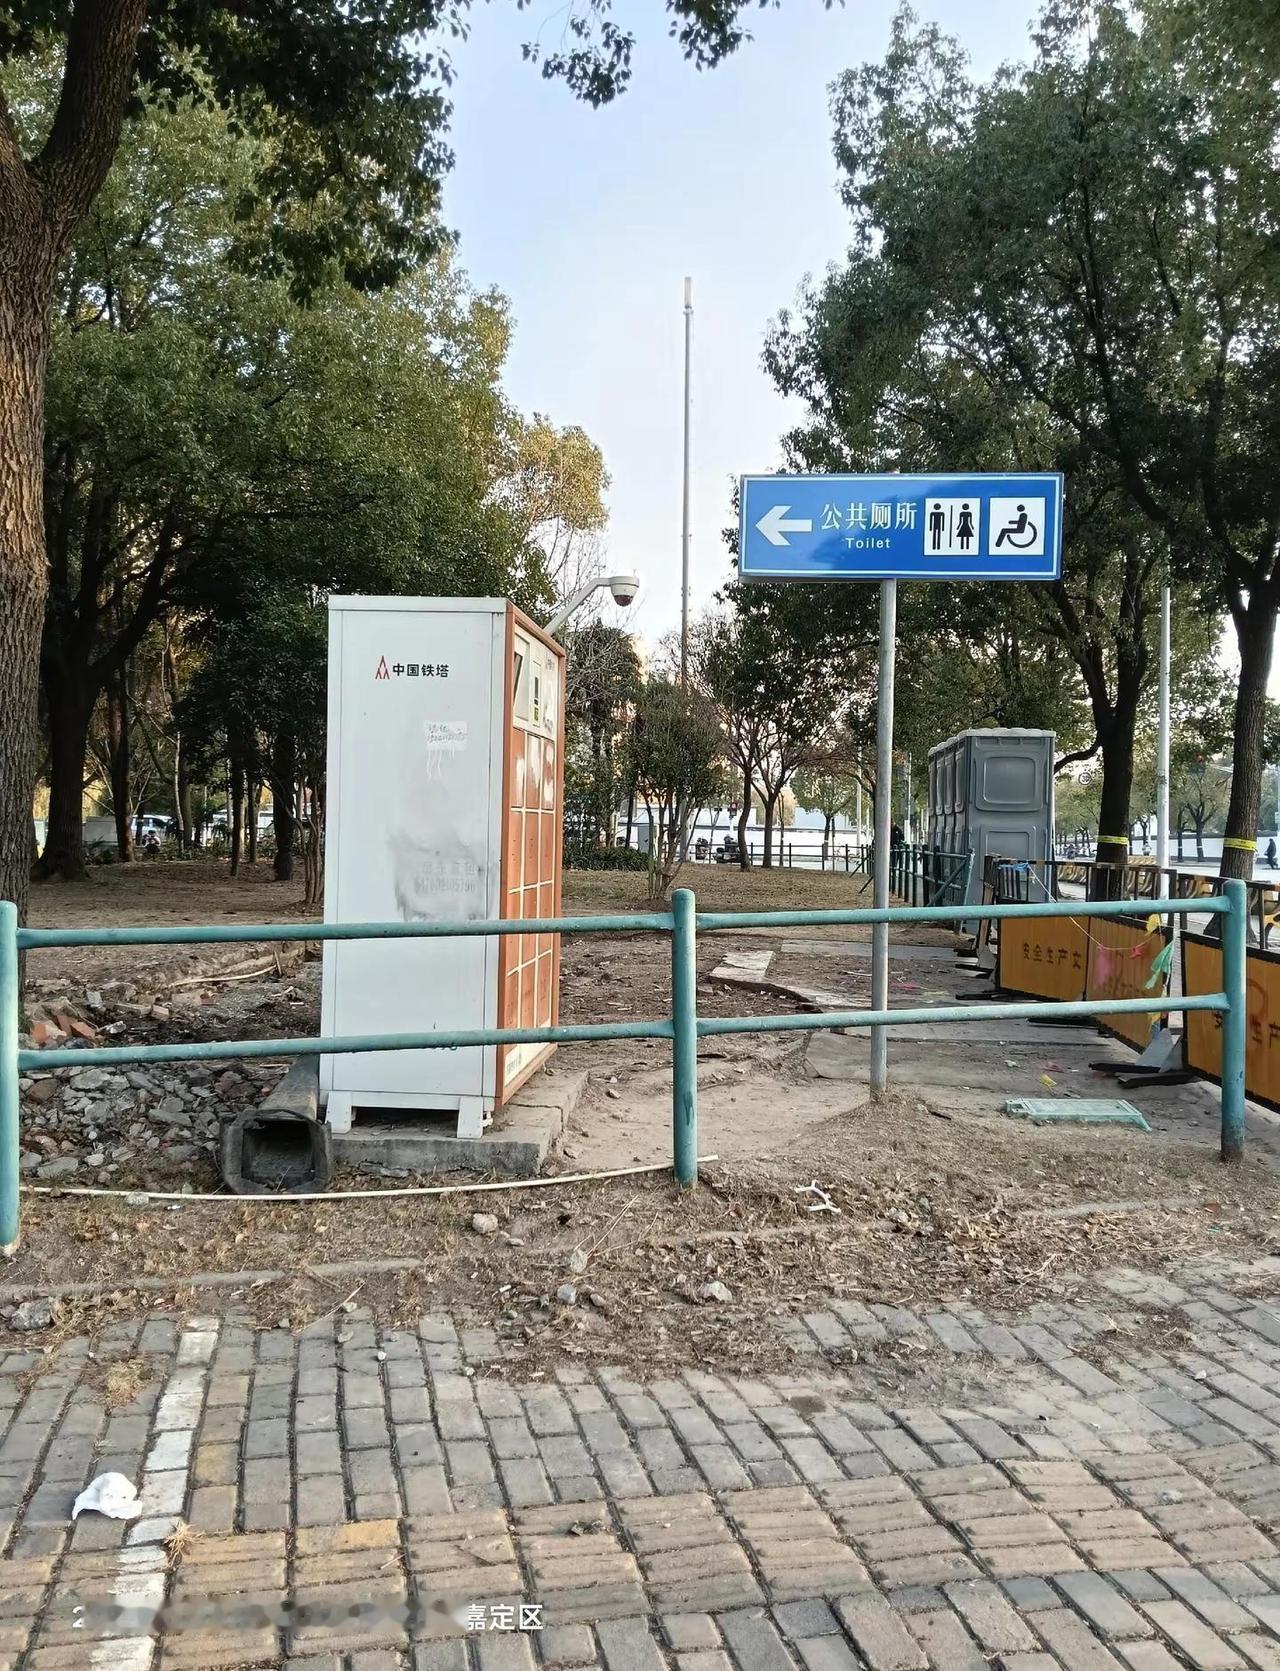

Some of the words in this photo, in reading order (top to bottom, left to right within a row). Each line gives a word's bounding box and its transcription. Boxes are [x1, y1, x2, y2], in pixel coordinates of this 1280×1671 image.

[819, 502, 918, 530] 公共厕所
[845, 537, 891, 549] Toilet
[392, 663, 449, 678] 中国铁塔
